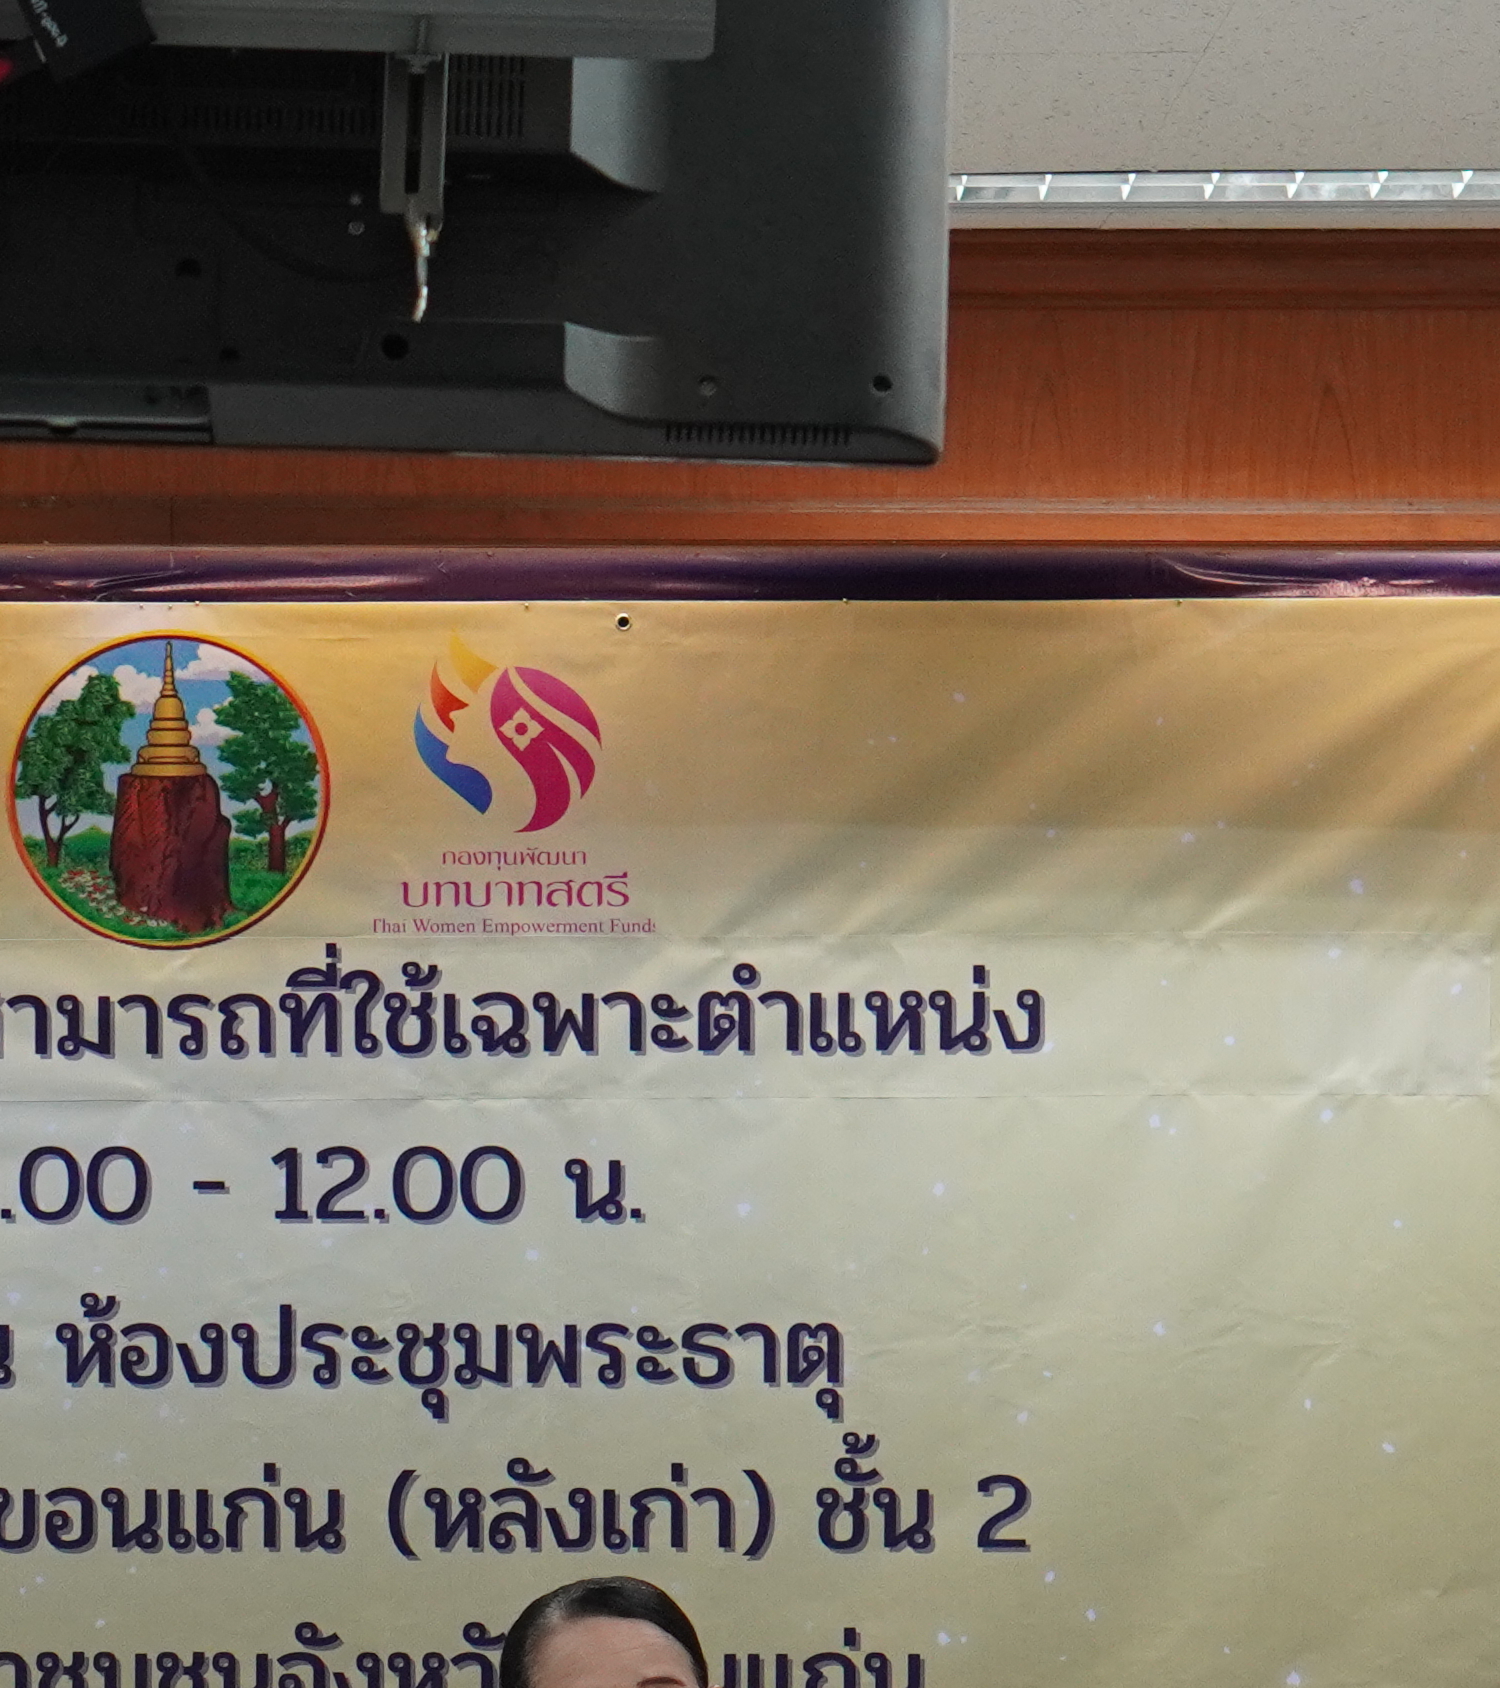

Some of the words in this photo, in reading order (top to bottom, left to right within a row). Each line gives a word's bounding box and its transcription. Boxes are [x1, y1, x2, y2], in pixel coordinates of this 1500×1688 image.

[441, 847, 587, 871] กองทุนพัฒนา
[400, 871, 631, 908] บทบาทสตรี
[373, 918, 407, 934] Thai
[413, 918, 477, 934] Women
[482, 918, 605, 937] Empowerment
[270, 1144, 523, 1222] 12.00
[563, 1157, 643, 1222] น.
[54, 1291, 841, 1421] ห้องประชุมพระธาตุ
[387, 1456, 773, 1559] (หลังเก่า)
[815, 1431, 933, 1552] ชั้น
[976, 1473, 1029, 1550] 2
